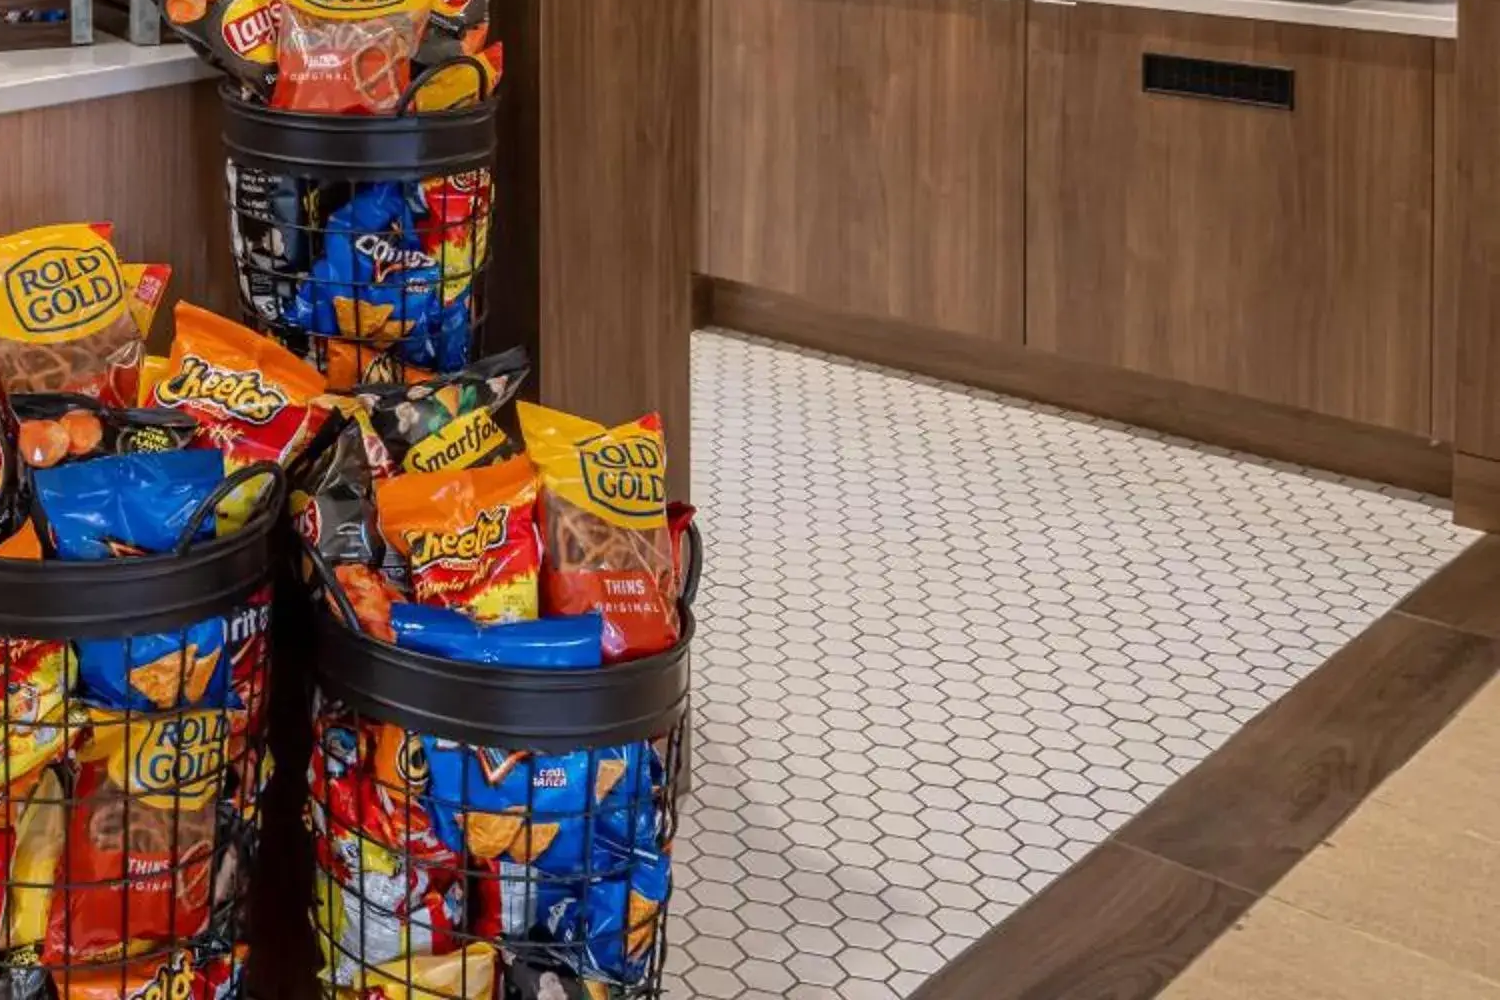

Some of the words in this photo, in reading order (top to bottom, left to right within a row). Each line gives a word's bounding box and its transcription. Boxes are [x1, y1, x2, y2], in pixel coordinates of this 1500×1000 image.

[18, 255, 101, 296] ROLD
[28, 276, 112, 323] GOLD
[157, 356, 283, 420] Cheetos
[598, 472, 665, 503] GOLD
[604, 579, 646, 596] THINS
